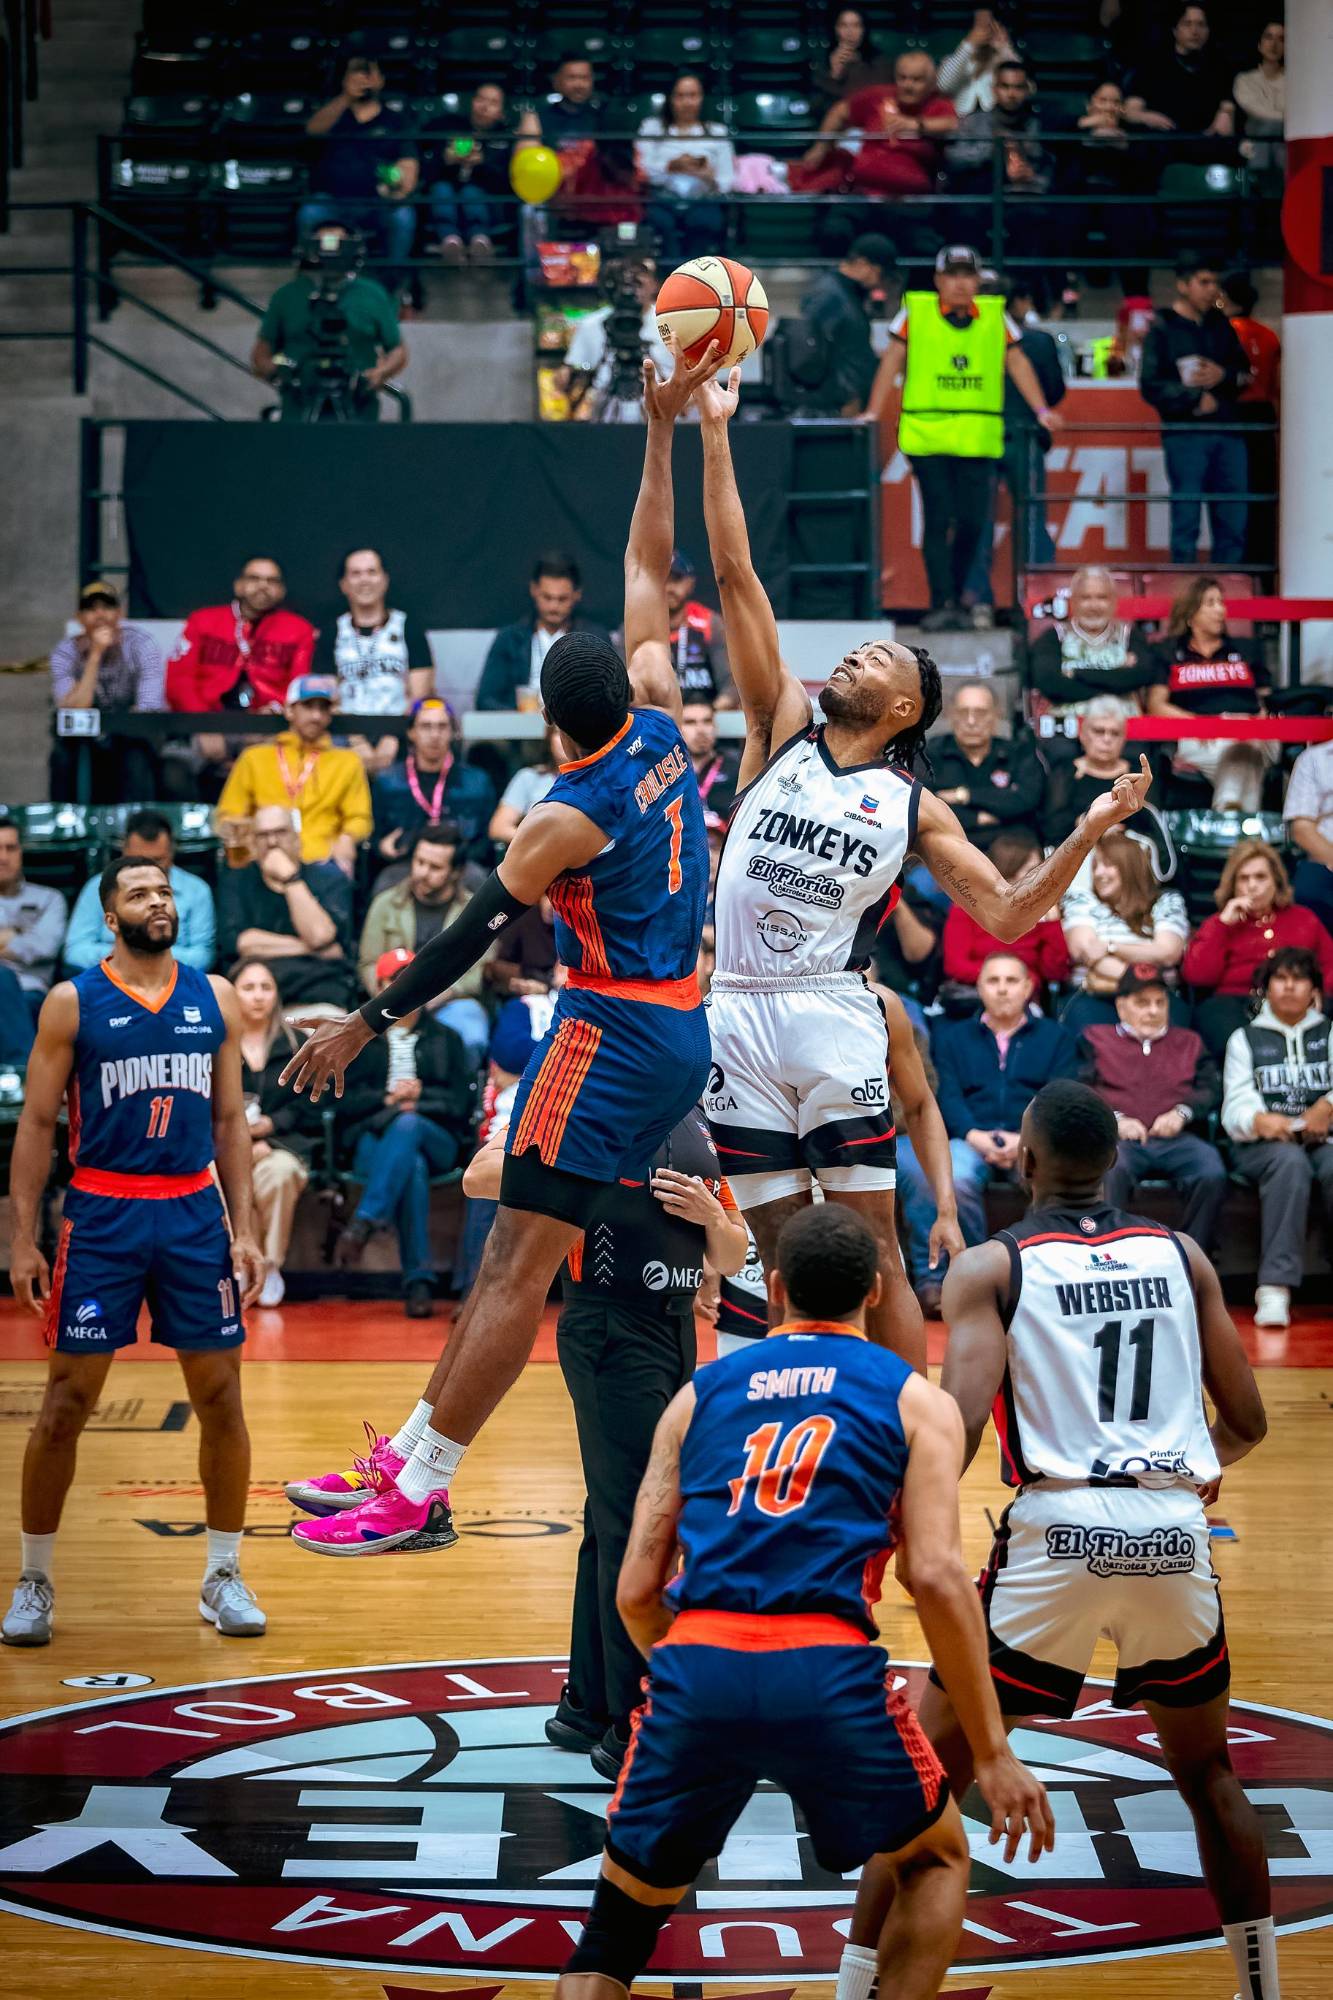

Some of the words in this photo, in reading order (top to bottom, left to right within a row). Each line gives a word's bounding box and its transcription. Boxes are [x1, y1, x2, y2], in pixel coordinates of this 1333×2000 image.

[664, 793, 684, 895] 1
[748, 808, 878, 878] ZONKEYS
[750, 859, 772, 879] El
[774, 866, 841, 898] Florido
[756, 922, 808, 942] NISSAN
[100, 1052, 212, 1109] PIONEROS
[851, 1078, 885, 1104] abc
[146, 1095, 174, 1138] 11
[1055, 1277, 1172, 1316] WEBSTER
[65, 1325, 107, 1339] MEGA
[747, 1366, 837, 1400] SMITH
[1093, 1318, 1154, 1422] 11
[727, 1414, 837, 1517] 10
[1050, 1528, 1083, 1555] El
[1090, 1531, 1193, 1559] Florido
[1093, 1559, 1147, 1571] Abarrotes
[1160, 1559, 1192, 1569] Carnes
